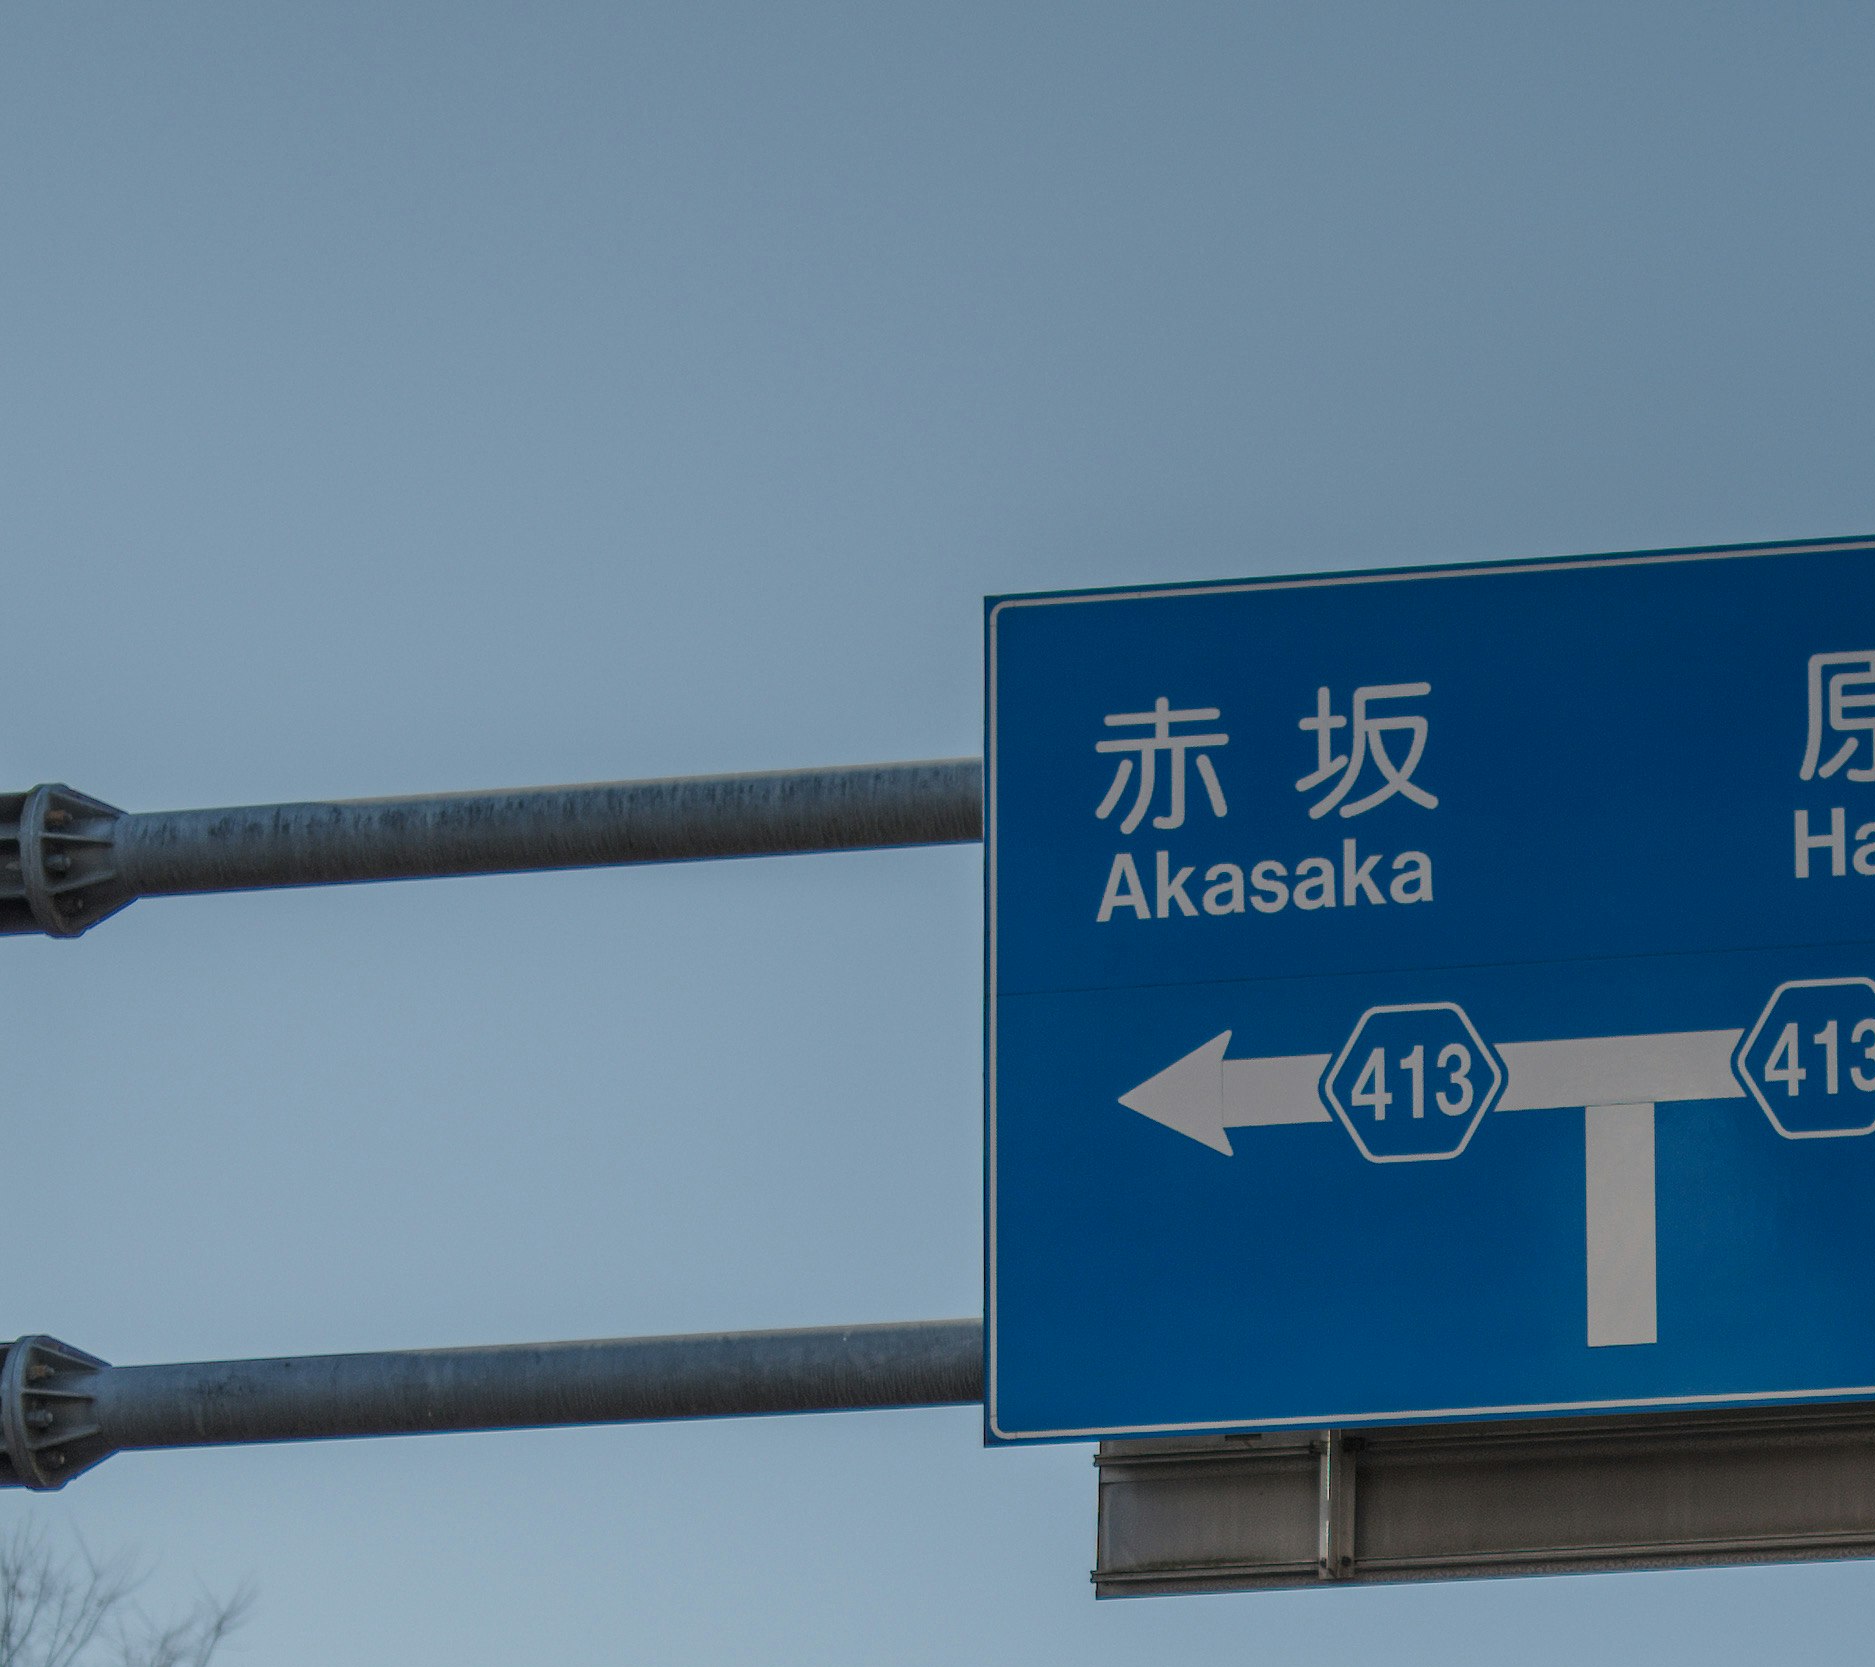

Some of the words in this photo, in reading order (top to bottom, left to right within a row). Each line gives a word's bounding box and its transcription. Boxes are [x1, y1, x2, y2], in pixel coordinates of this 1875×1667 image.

[1096, 681, 1439, 834] 赤坂
[1096, 839, 1433, 923] Akasaka
[1352, 1043, 1474, 1121] 413
